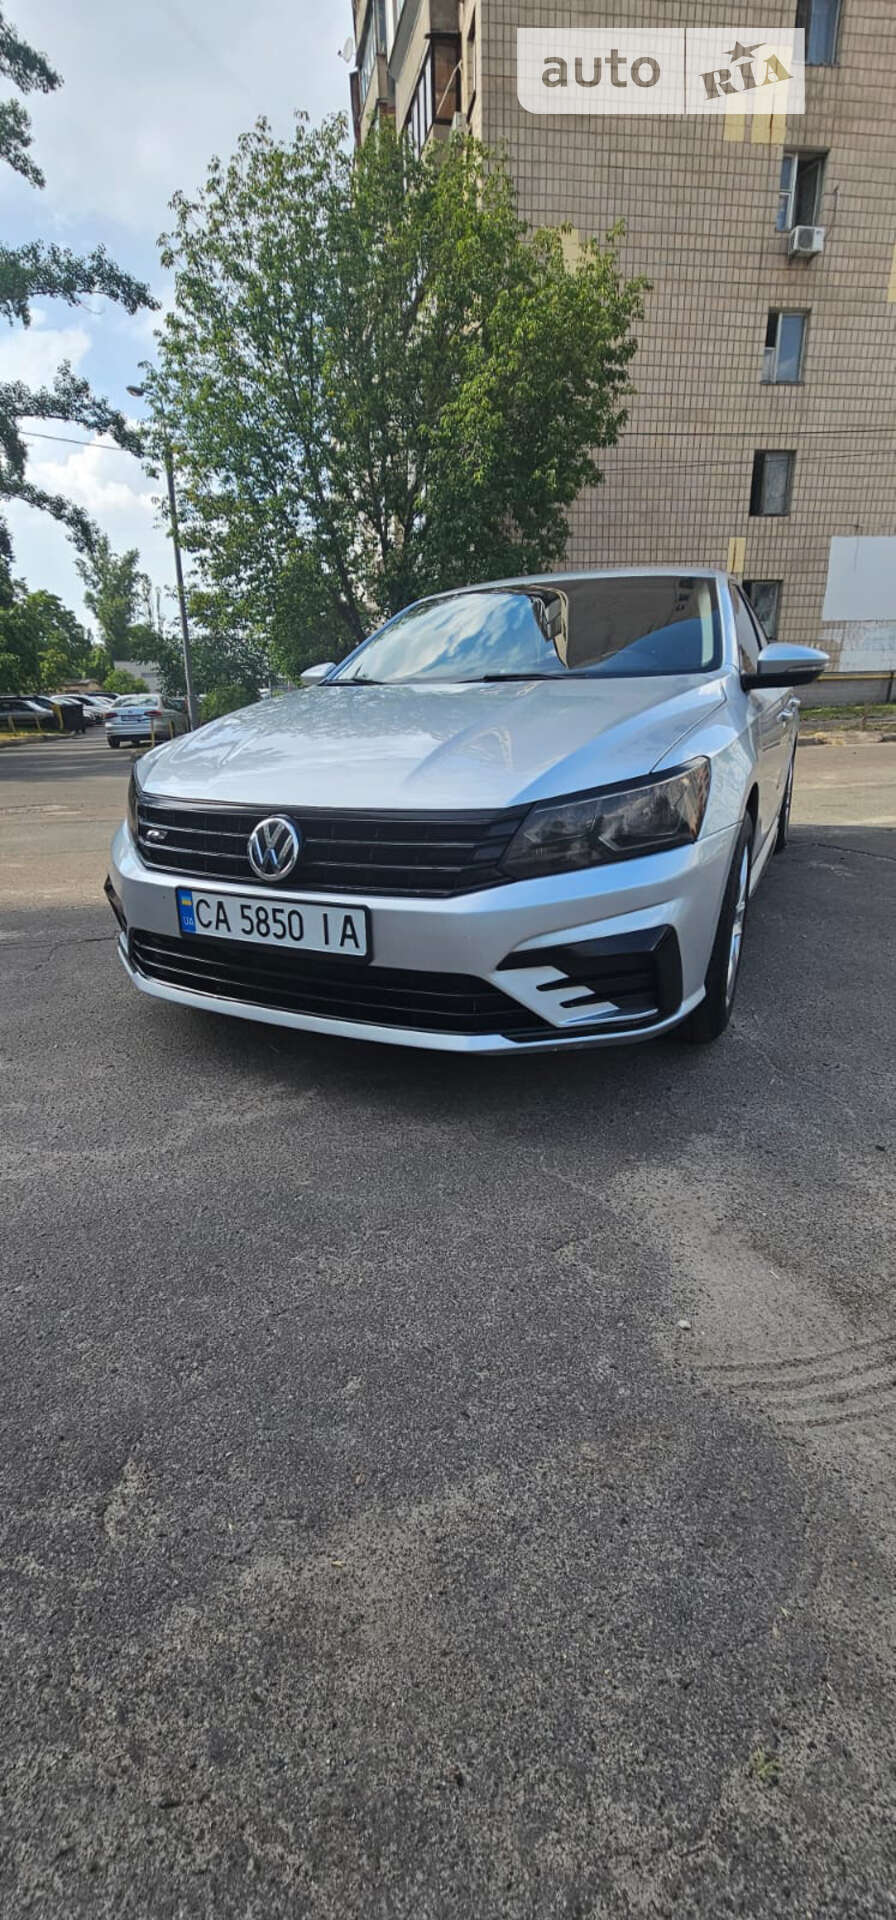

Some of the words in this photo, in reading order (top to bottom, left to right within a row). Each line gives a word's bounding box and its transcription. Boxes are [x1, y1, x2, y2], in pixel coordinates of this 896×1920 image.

[196, 899, 231, 932] CA
[240, 904, 304, 942] 5850
[322, 913, 360, 949] IA
